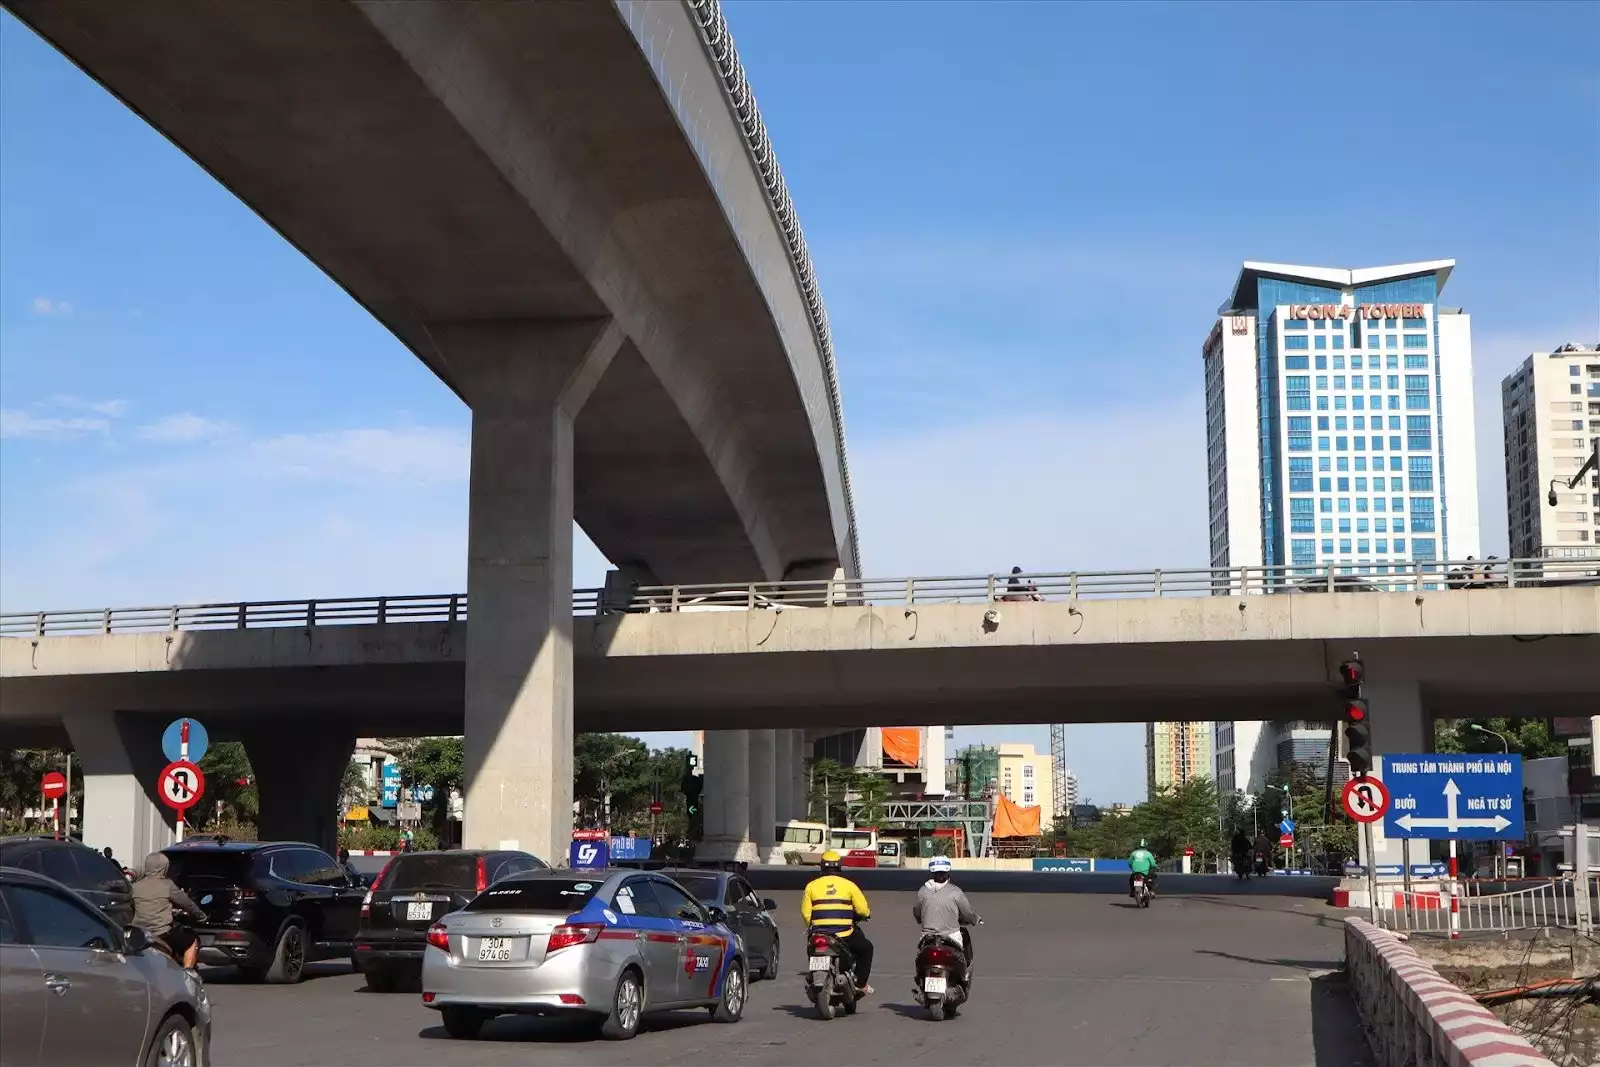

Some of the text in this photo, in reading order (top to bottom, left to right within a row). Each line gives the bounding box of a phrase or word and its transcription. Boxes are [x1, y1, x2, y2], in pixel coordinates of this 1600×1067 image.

[1290, 303, 1425, 321] ICON 4 TOWER
[1392, 758, 1512, 775] TRUNG TÂM THÀNH PHỐ HÀ NỘI
[1394, 793, 1416, 810] BƯỞI
[1467, 794, 1512, 810] NGÃ TƯ SỞ
[487, 936, 504, 949] 30A
[695, 956, 709, 968] TAXI
